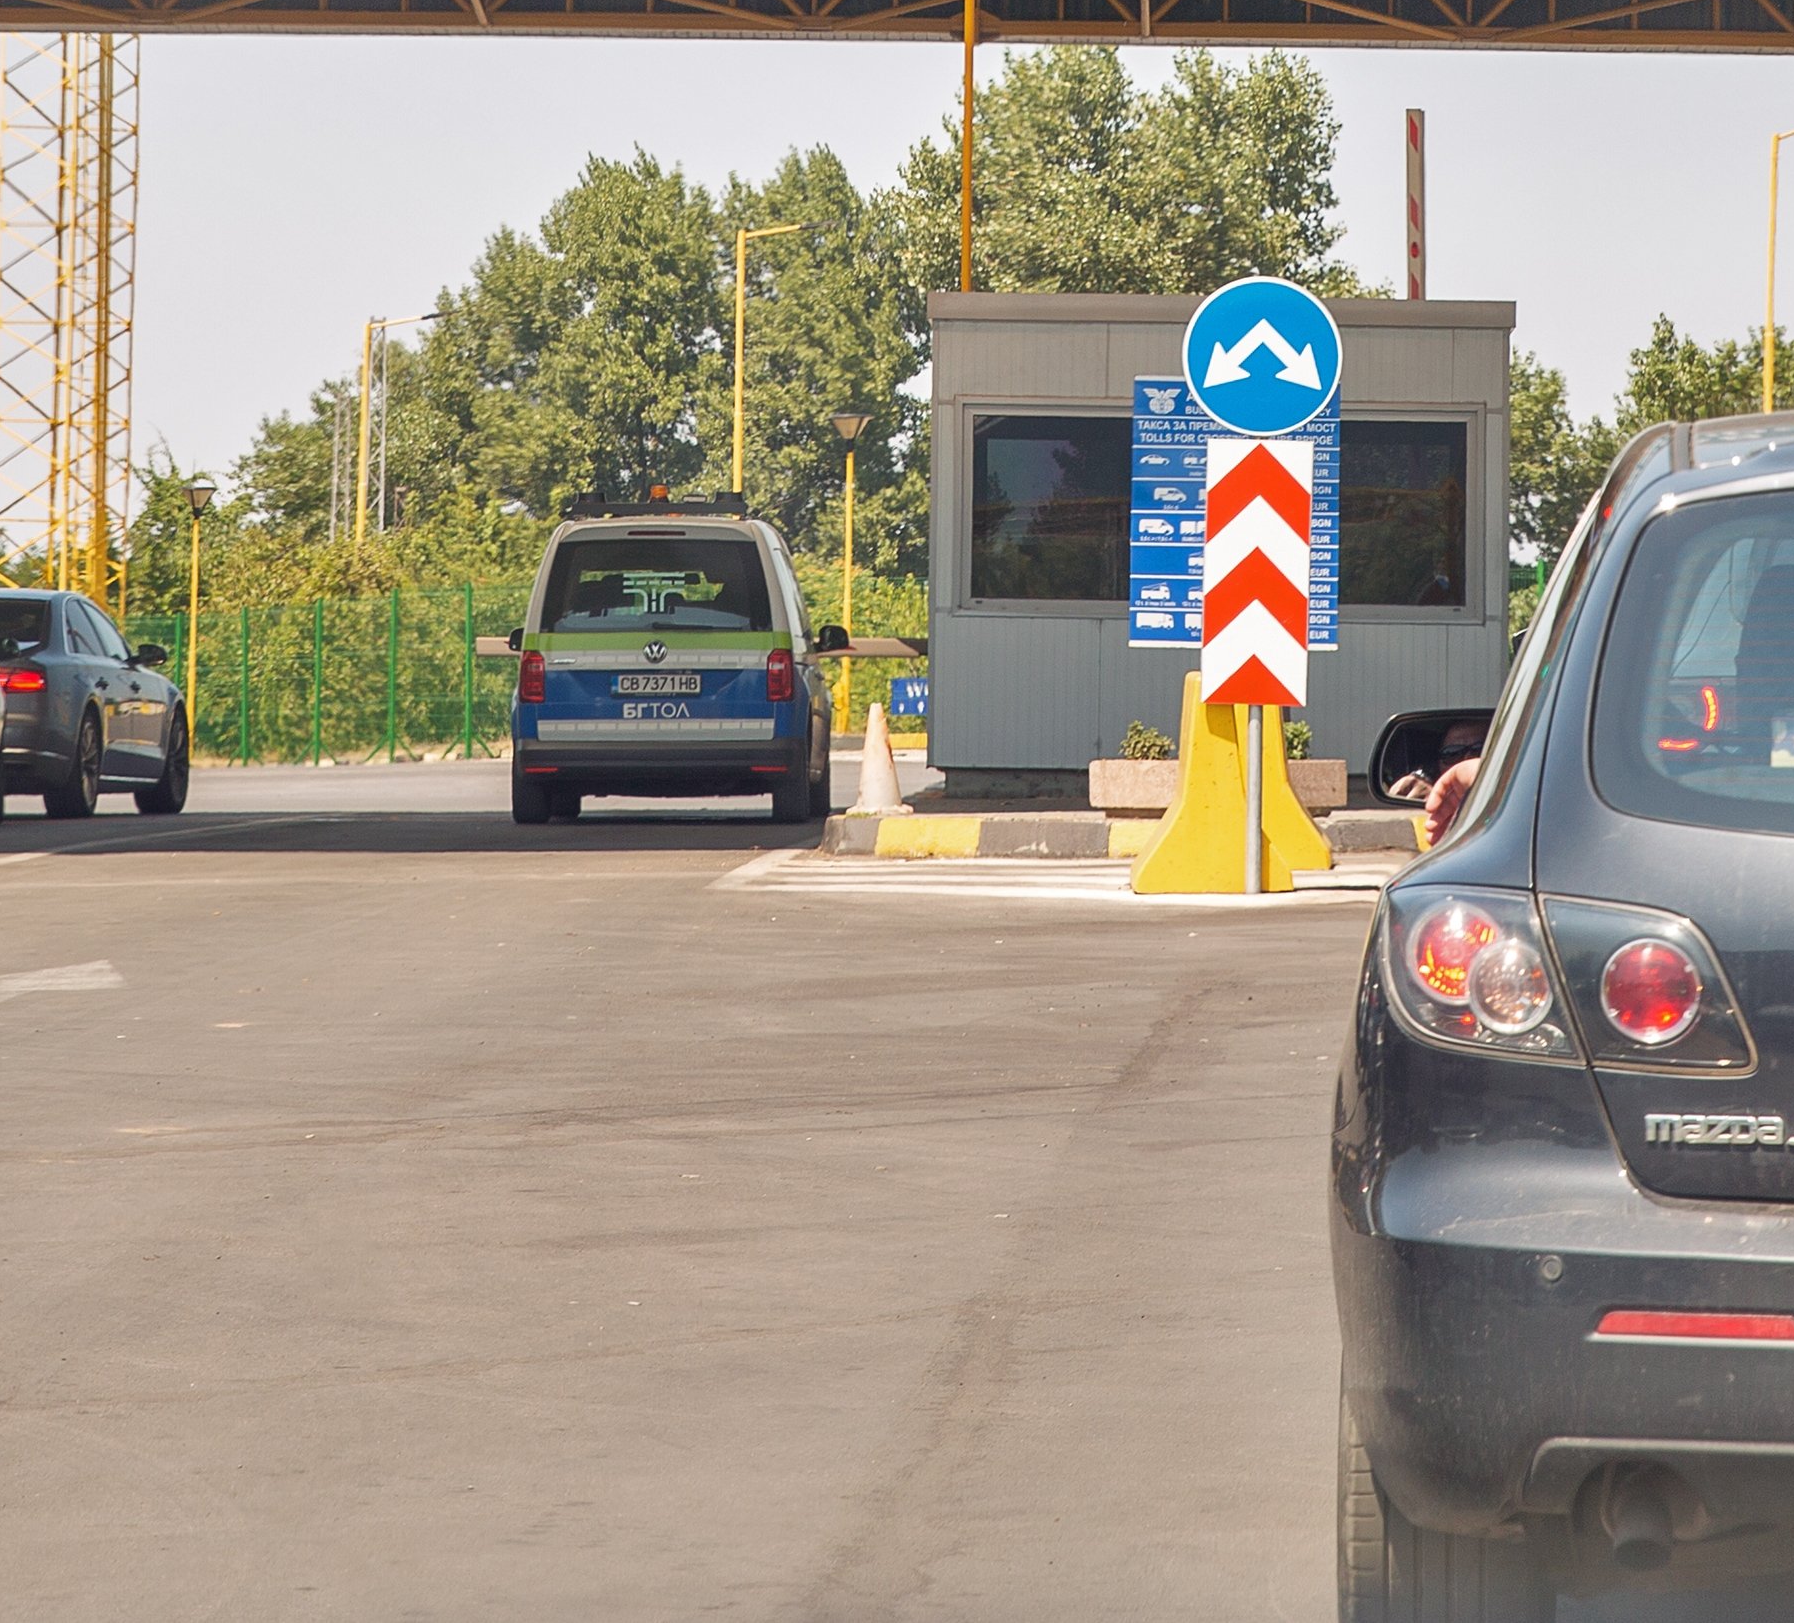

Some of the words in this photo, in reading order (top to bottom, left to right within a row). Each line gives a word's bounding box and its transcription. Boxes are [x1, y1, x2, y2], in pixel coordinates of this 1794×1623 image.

[1137, 420, 1171, 431] ТАКСА
[1172, 420, 1188, 431] ЗА
[1307, 423, 1337, 433] МОСТ
[1140, 433, 1173, 443] TOLLS
[1174, 433, 1196, 443] FOR
[1309, 599, 1330, 609] EUR
[1309, 615, 1331, 624] BGN
[1308, 630, 1330, 640] EUR
[620, 677, 640, 691] CB
[642, 677, 676, 691] 7371
